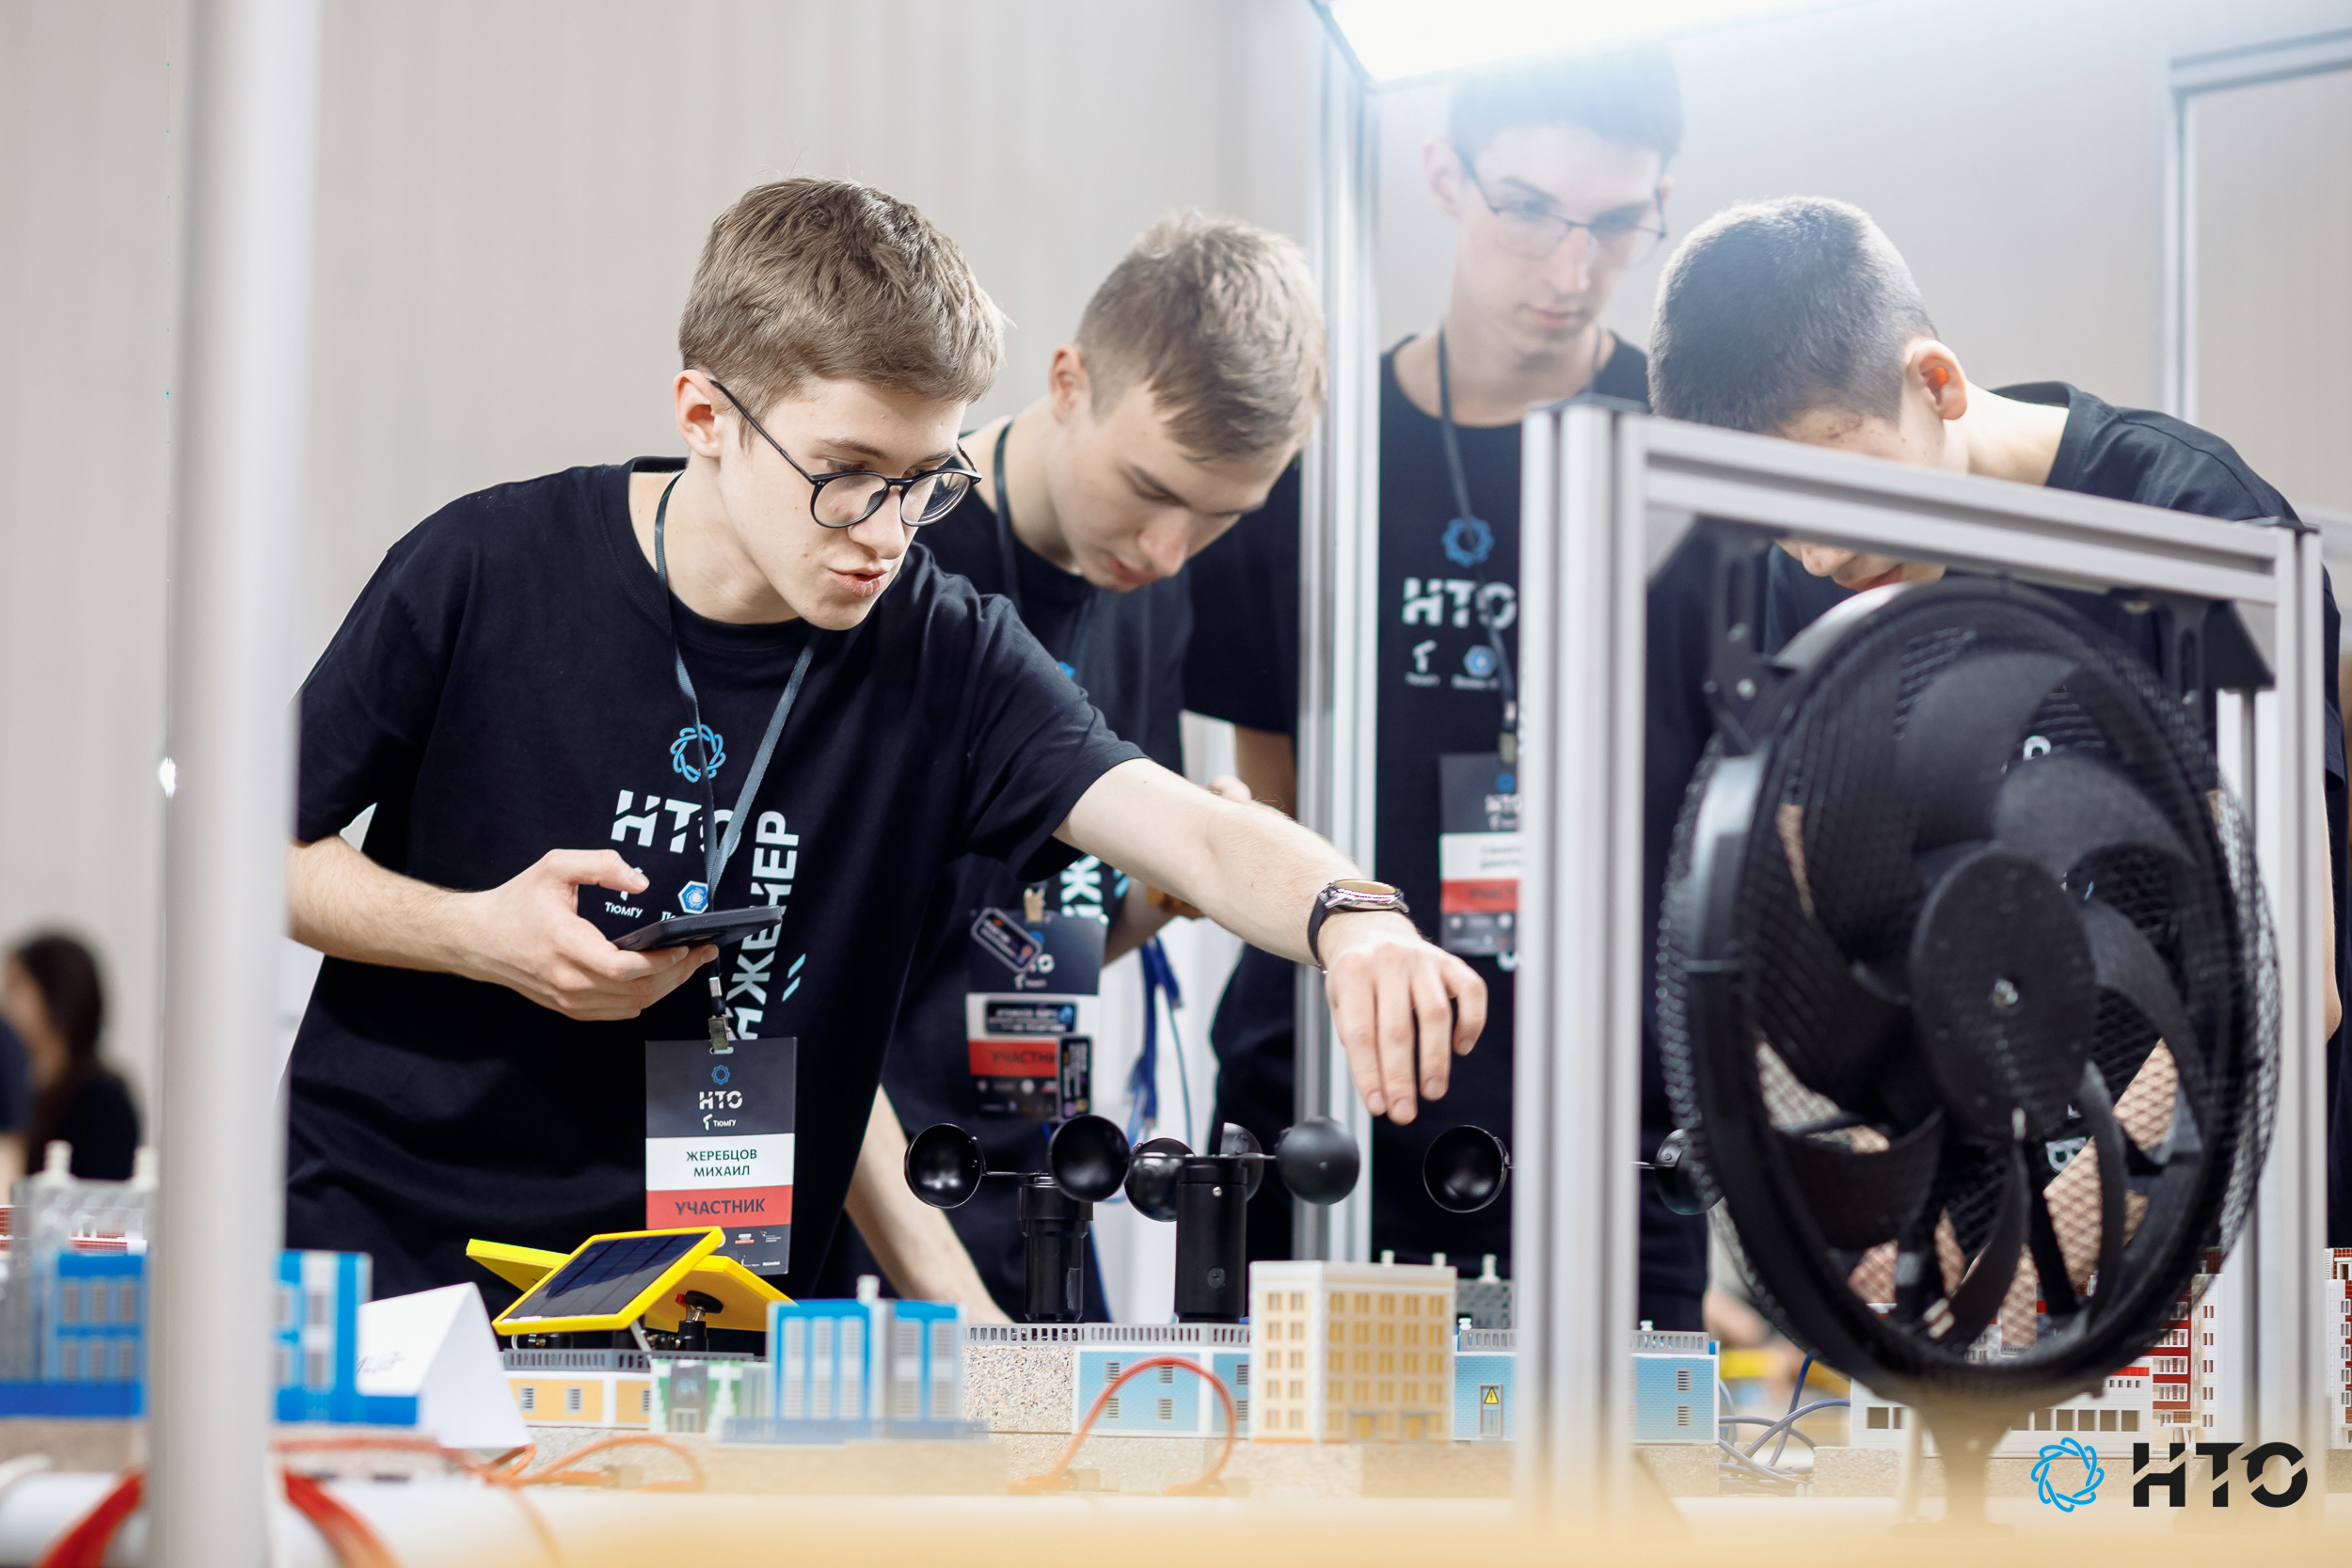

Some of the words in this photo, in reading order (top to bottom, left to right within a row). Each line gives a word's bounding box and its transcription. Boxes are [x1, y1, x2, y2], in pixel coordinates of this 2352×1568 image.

[1402, 577, 1517, 630] НТО
[699, 1090, 743, 1110] НТО
[686, 1148, 757, 1163] ЖЕРЕБЦОВ
[693, 1165, 750, 1178] МИХАИЛ
[675, 1197, 766, 1216] УЧАСТНИК
